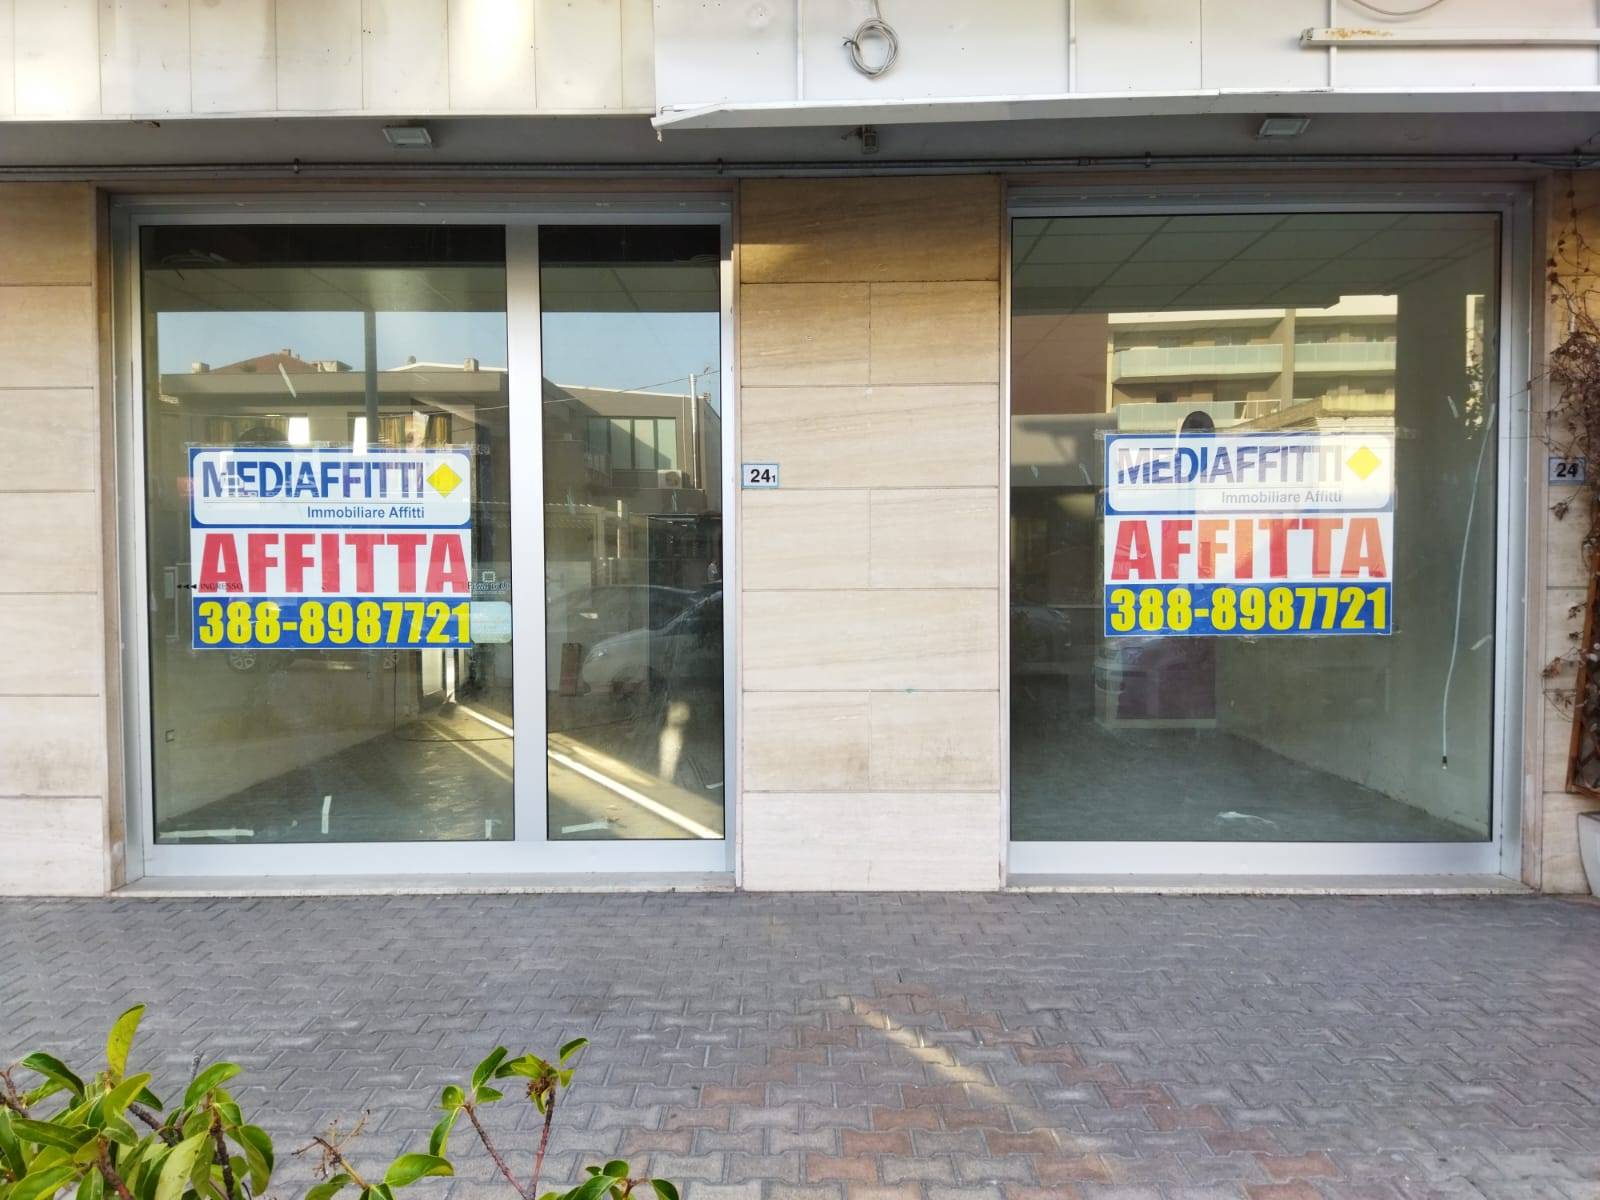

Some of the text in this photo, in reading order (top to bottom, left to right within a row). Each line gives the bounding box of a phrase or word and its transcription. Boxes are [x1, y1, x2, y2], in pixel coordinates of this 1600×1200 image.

[203, 461, 424, 498] MEDIAFFITTI
[1117, 445, 1342, 485] MEDIAFFITTI
[1556, 463, 1579, 477] 24
[307, 506, 425, 519] Immobiliare Affitti
[1221, 491, 1342, 504] Immobiliare Affitti
[199, 533, 470, 593] AFFITTA
[1110, 517, 1387, 580] AFFITTA
[198, 600, 471, 645] 388-8987721
[1110, 586, 1387, 632] 388-8987721
